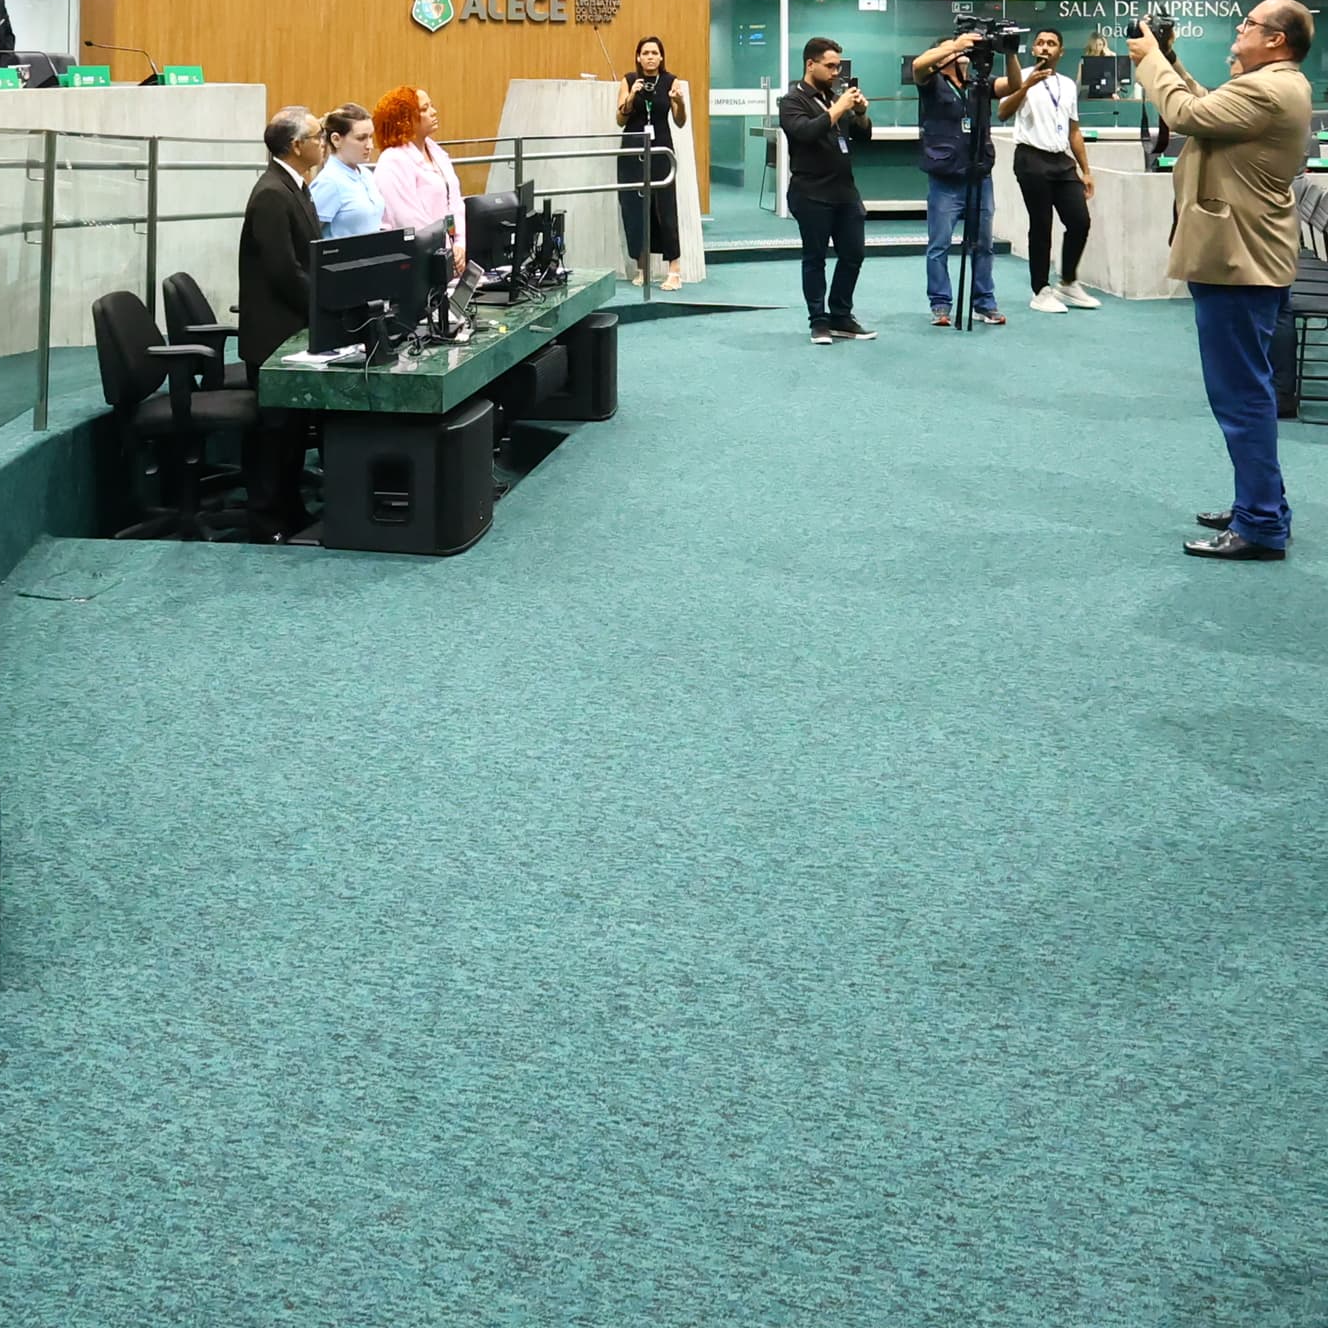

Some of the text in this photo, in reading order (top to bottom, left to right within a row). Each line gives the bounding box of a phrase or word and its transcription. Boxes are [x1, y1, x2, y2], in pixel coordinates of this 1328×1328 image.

[1059, 0, 1243, 17] SALA DE IMPRENSA
